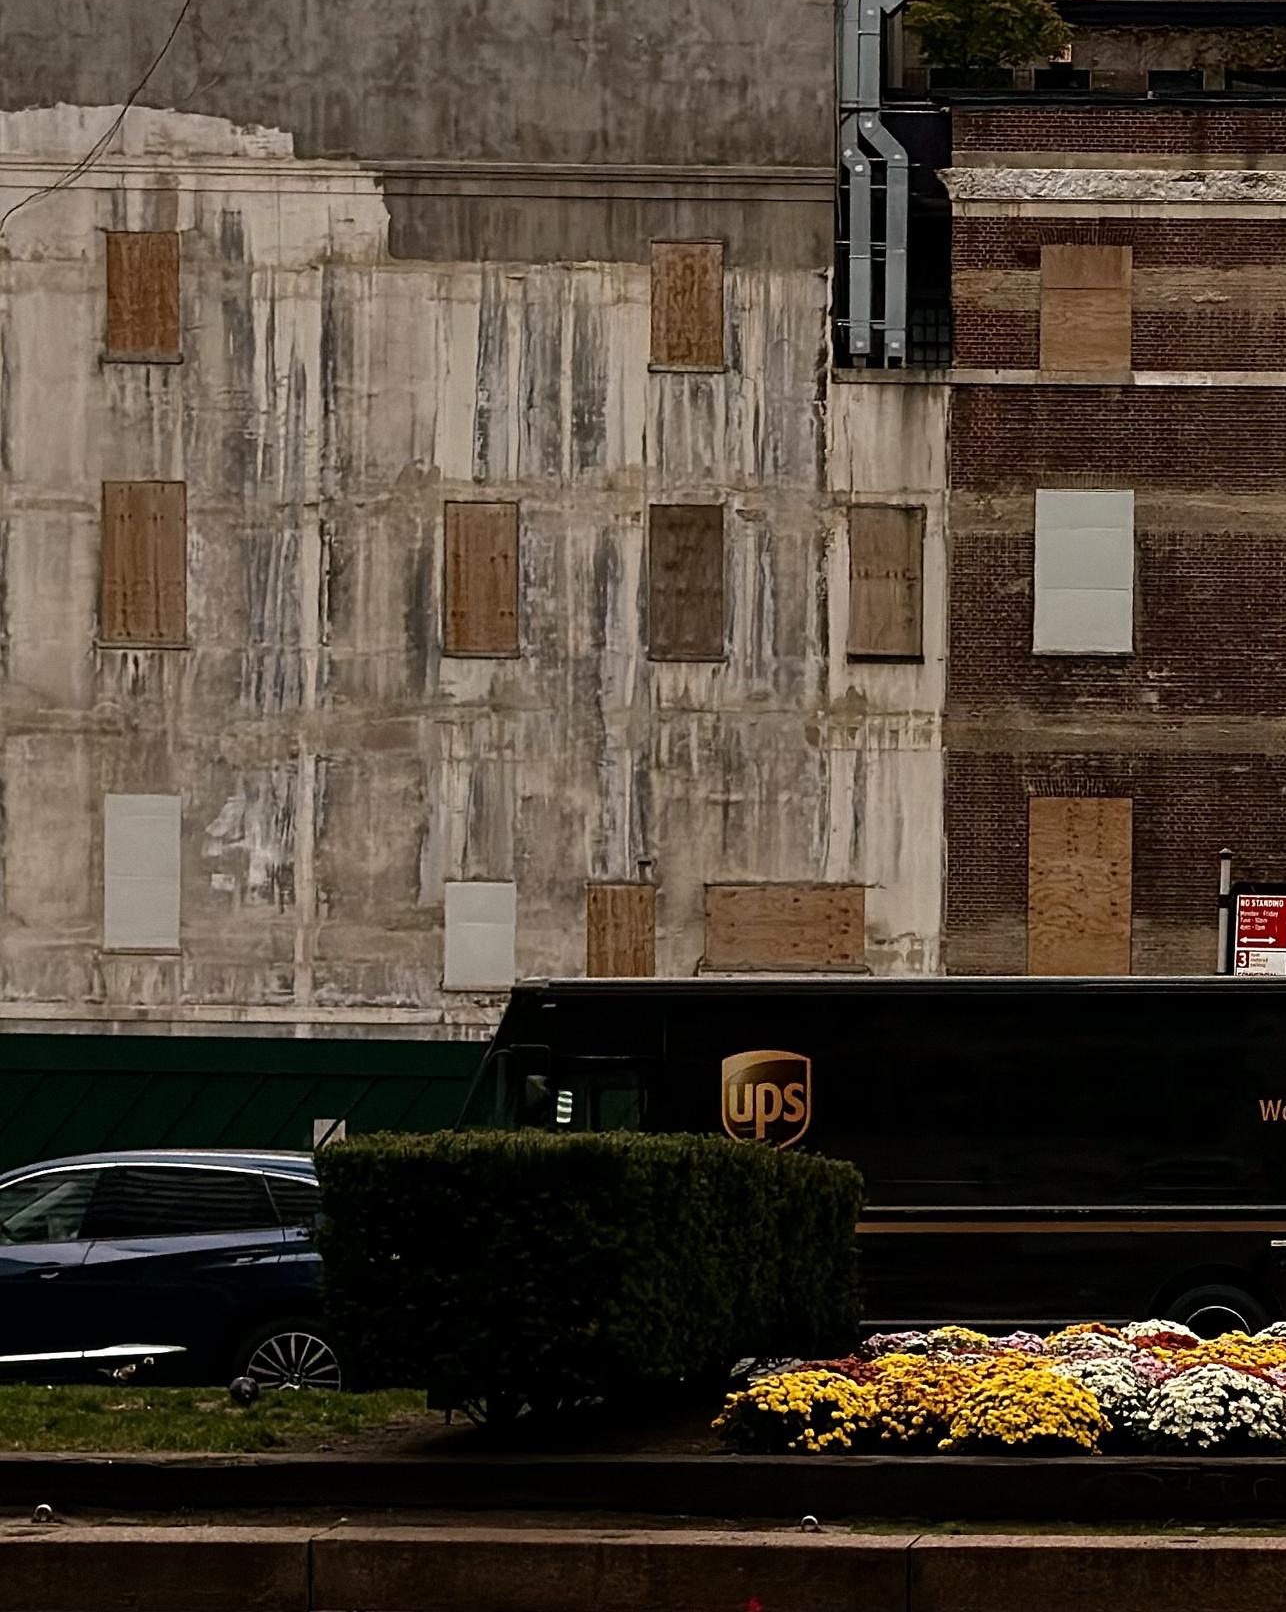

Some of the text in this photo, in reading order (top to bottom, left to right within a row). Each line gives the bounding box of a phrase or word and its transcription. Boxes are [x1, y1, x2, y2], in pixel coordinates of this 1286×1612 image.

[1240, 899, 1284, 907] NO STANDING
[1237, 952, 1247, 967] 3
[728, 1082, 806, 1140] ups
